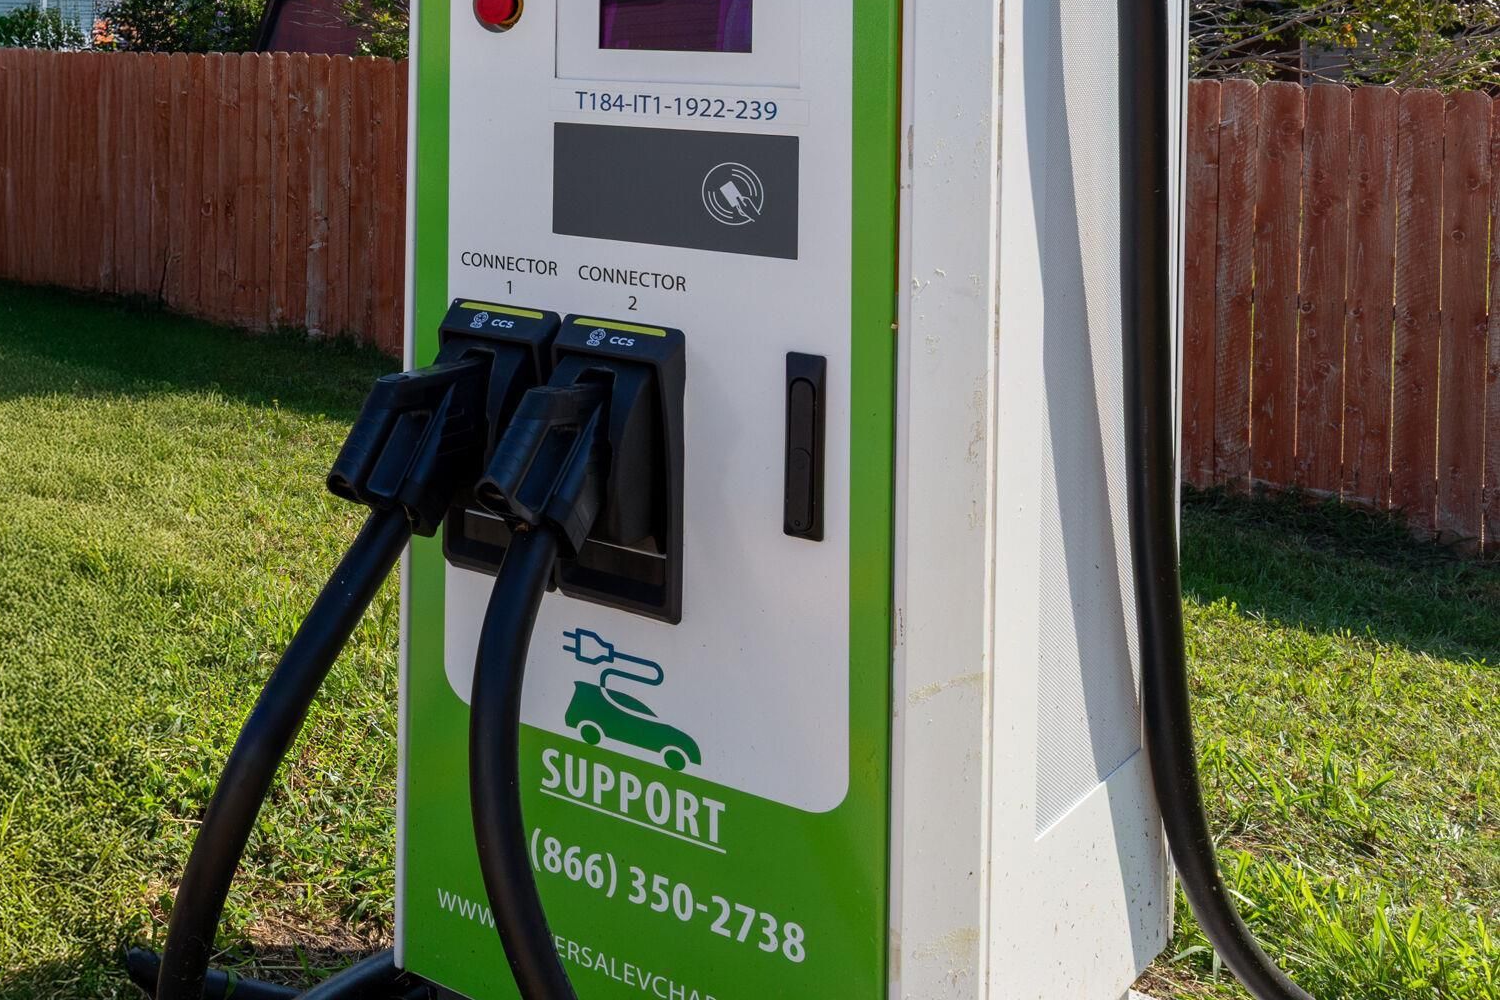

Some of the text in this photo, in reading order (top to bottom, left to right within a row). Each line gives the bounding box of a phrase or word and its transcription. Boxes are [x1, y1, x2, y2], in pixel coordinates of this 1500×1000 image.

[574, 90, 778, 121] T184-IT1-1922-239
[460, 251, 558, 277] CONNECTOR
[506, 280, 513, 295] 1
[578, 265, 687, 292] CONNECTOR
[628, 296, 638, 311] 2
[491, 318, 514, 329] CCS
[609, 335, 635, 347] CCS
[539, 747, 726, 844] SUPPORT
[530, 827, 807, 964] (866) 350-2738
